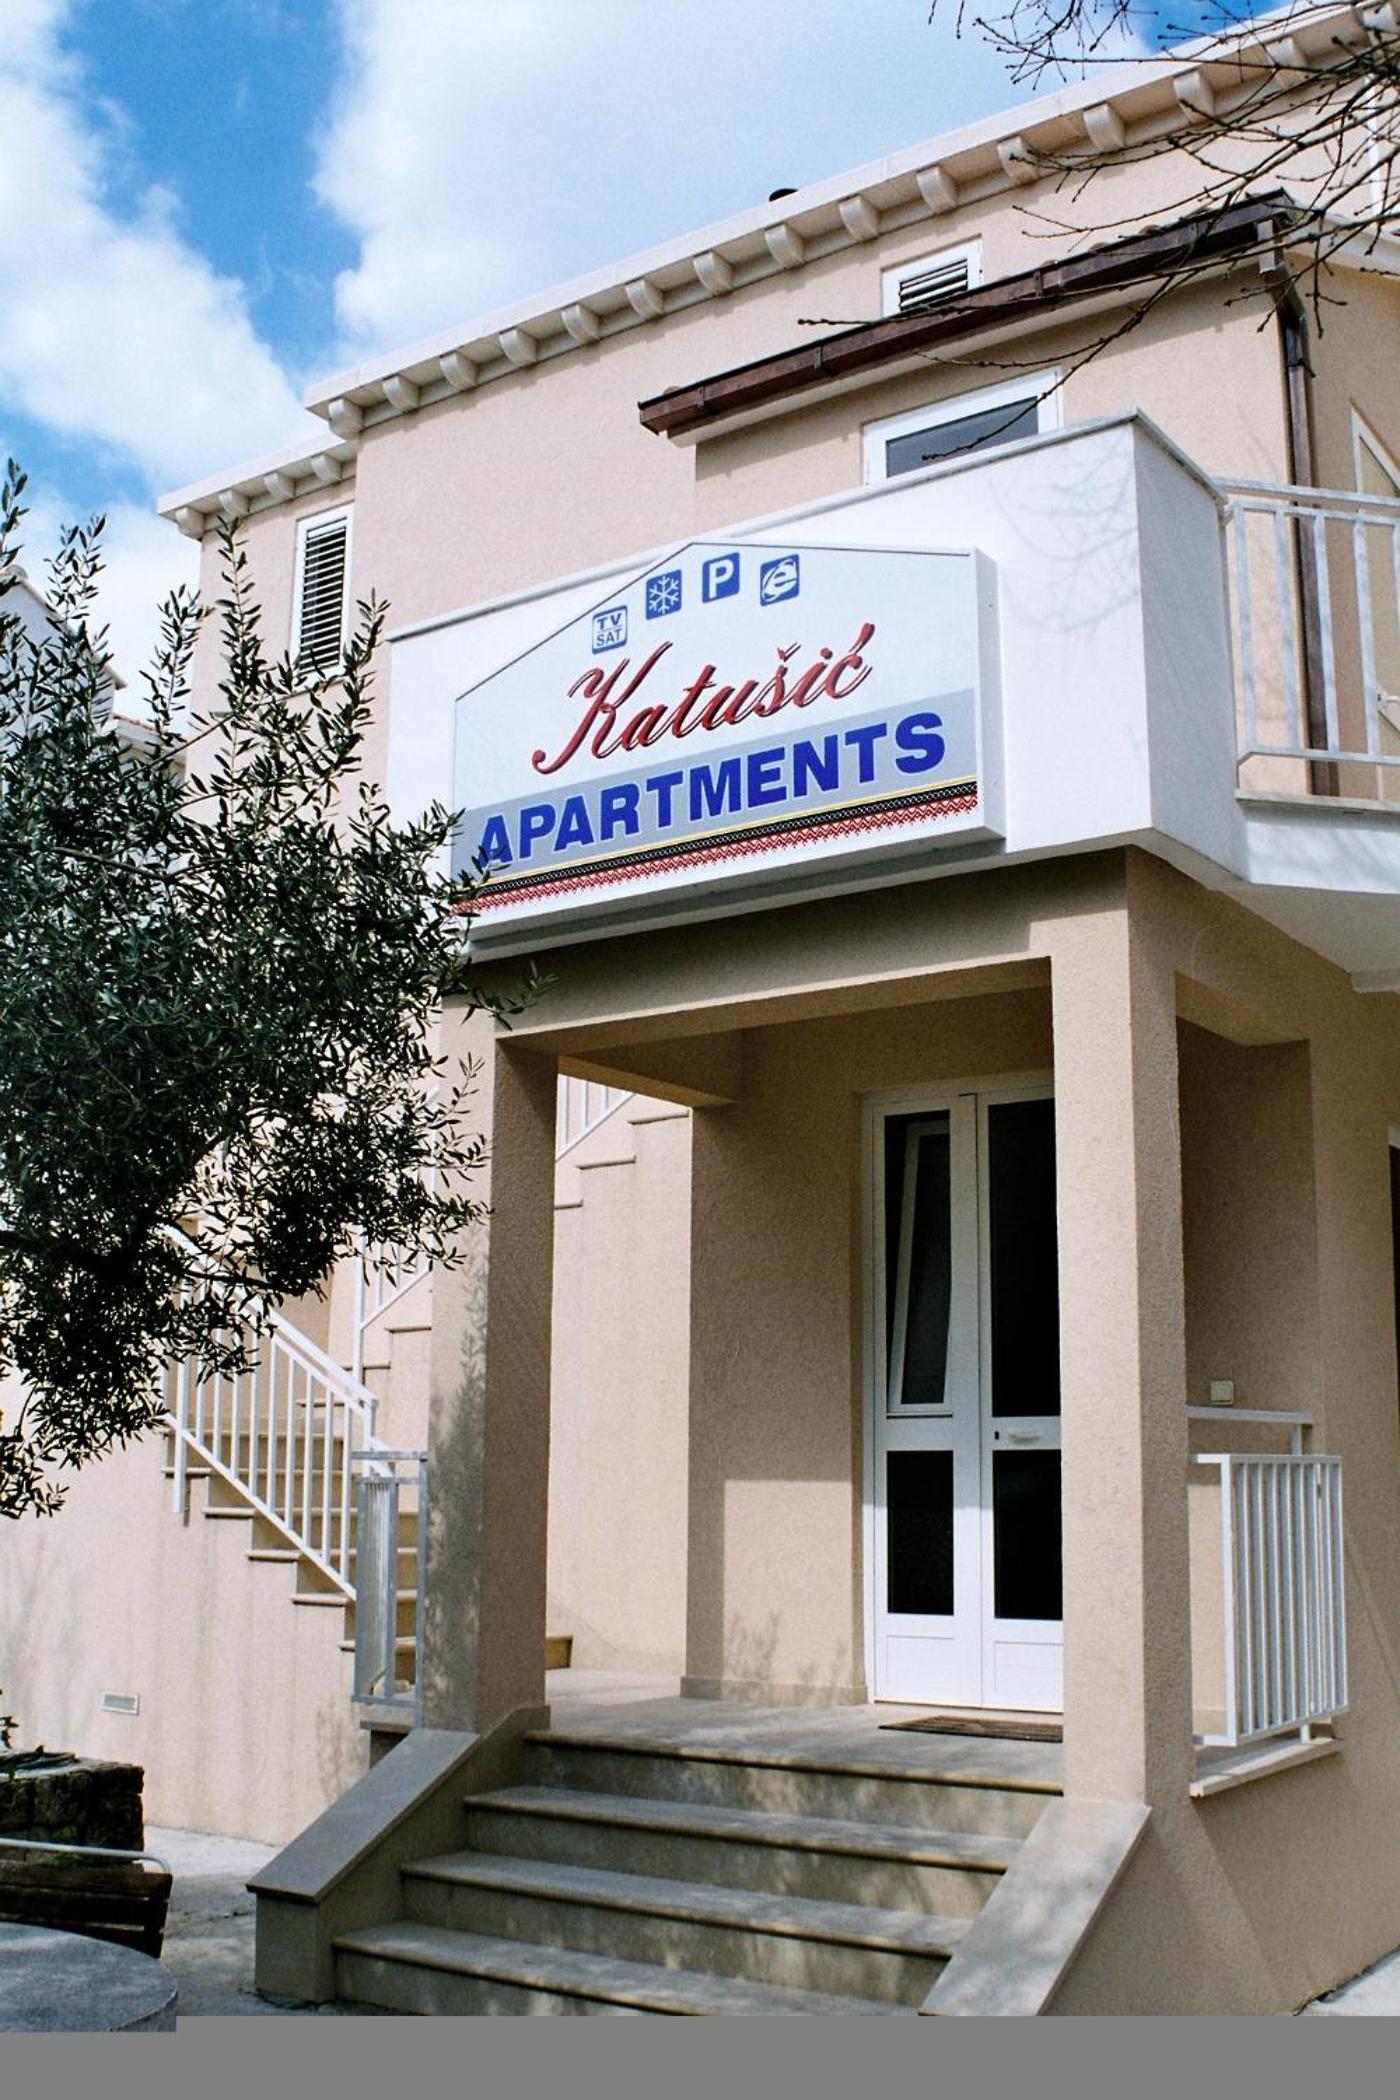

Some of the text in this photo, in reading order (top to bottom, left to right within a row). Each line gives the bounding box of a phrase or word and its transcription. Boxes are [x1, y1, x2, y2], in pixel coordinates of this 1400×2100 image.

[709, 559, 734, 599] P
[596, 612, 622, 630] TV
[596, 628, 623, 647] SAT
[531, 622, 876, 775] Katušić
[477, 712, 946, 868] APARTMENTS
